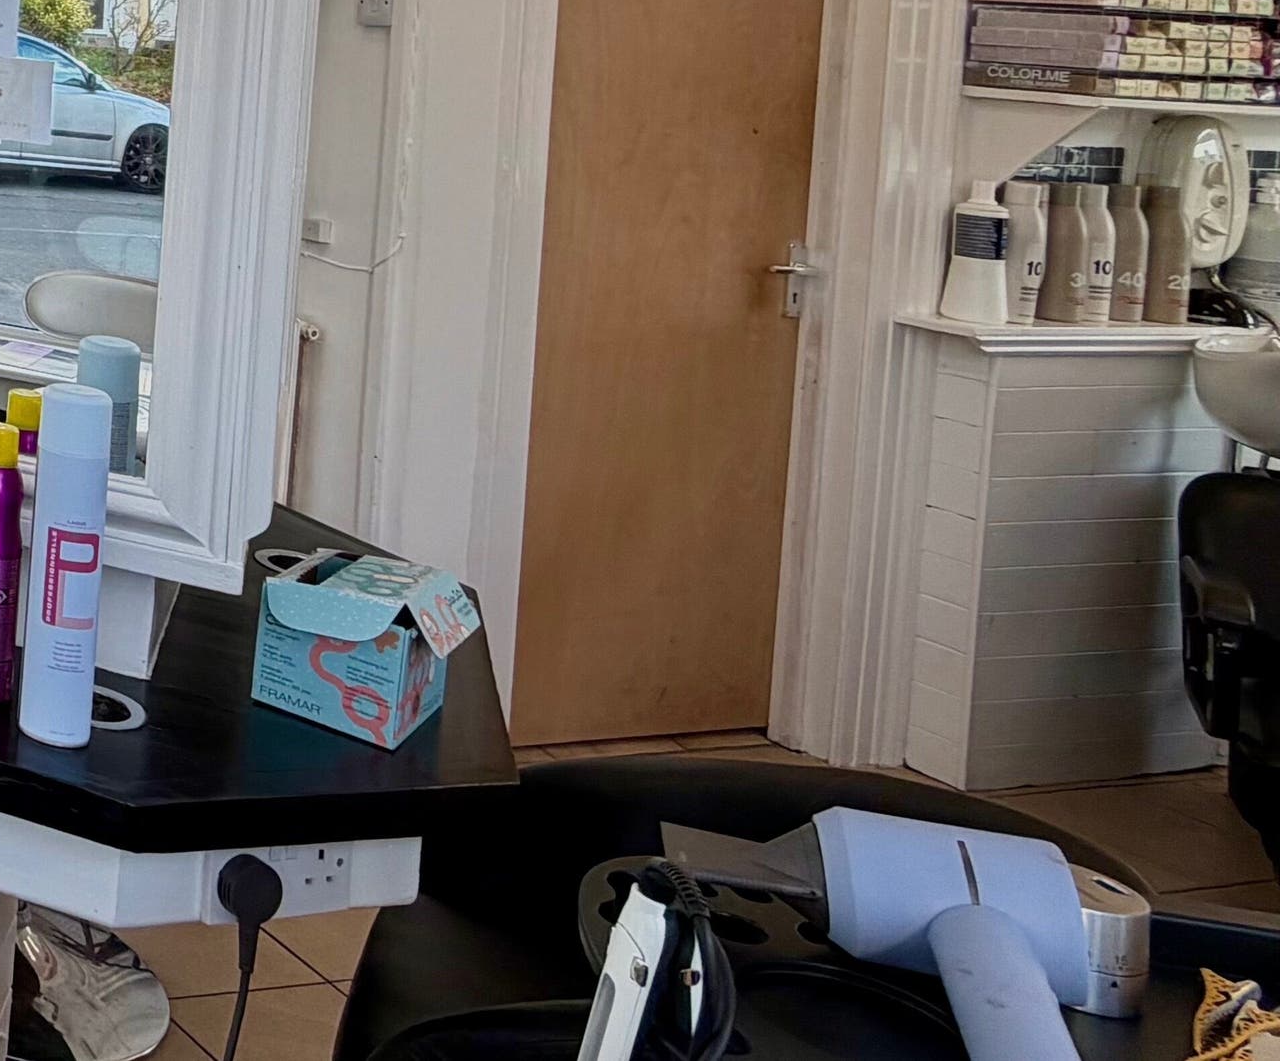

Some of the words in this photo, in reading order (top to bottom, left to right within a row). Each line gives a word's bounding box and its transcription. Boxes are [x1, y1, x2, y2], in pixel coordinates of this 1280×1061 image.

[1093, 260, 1113, 276] 10
[1117, 272, 1143, 287] 40
[260, 684, 323, 715] FRAMAR
